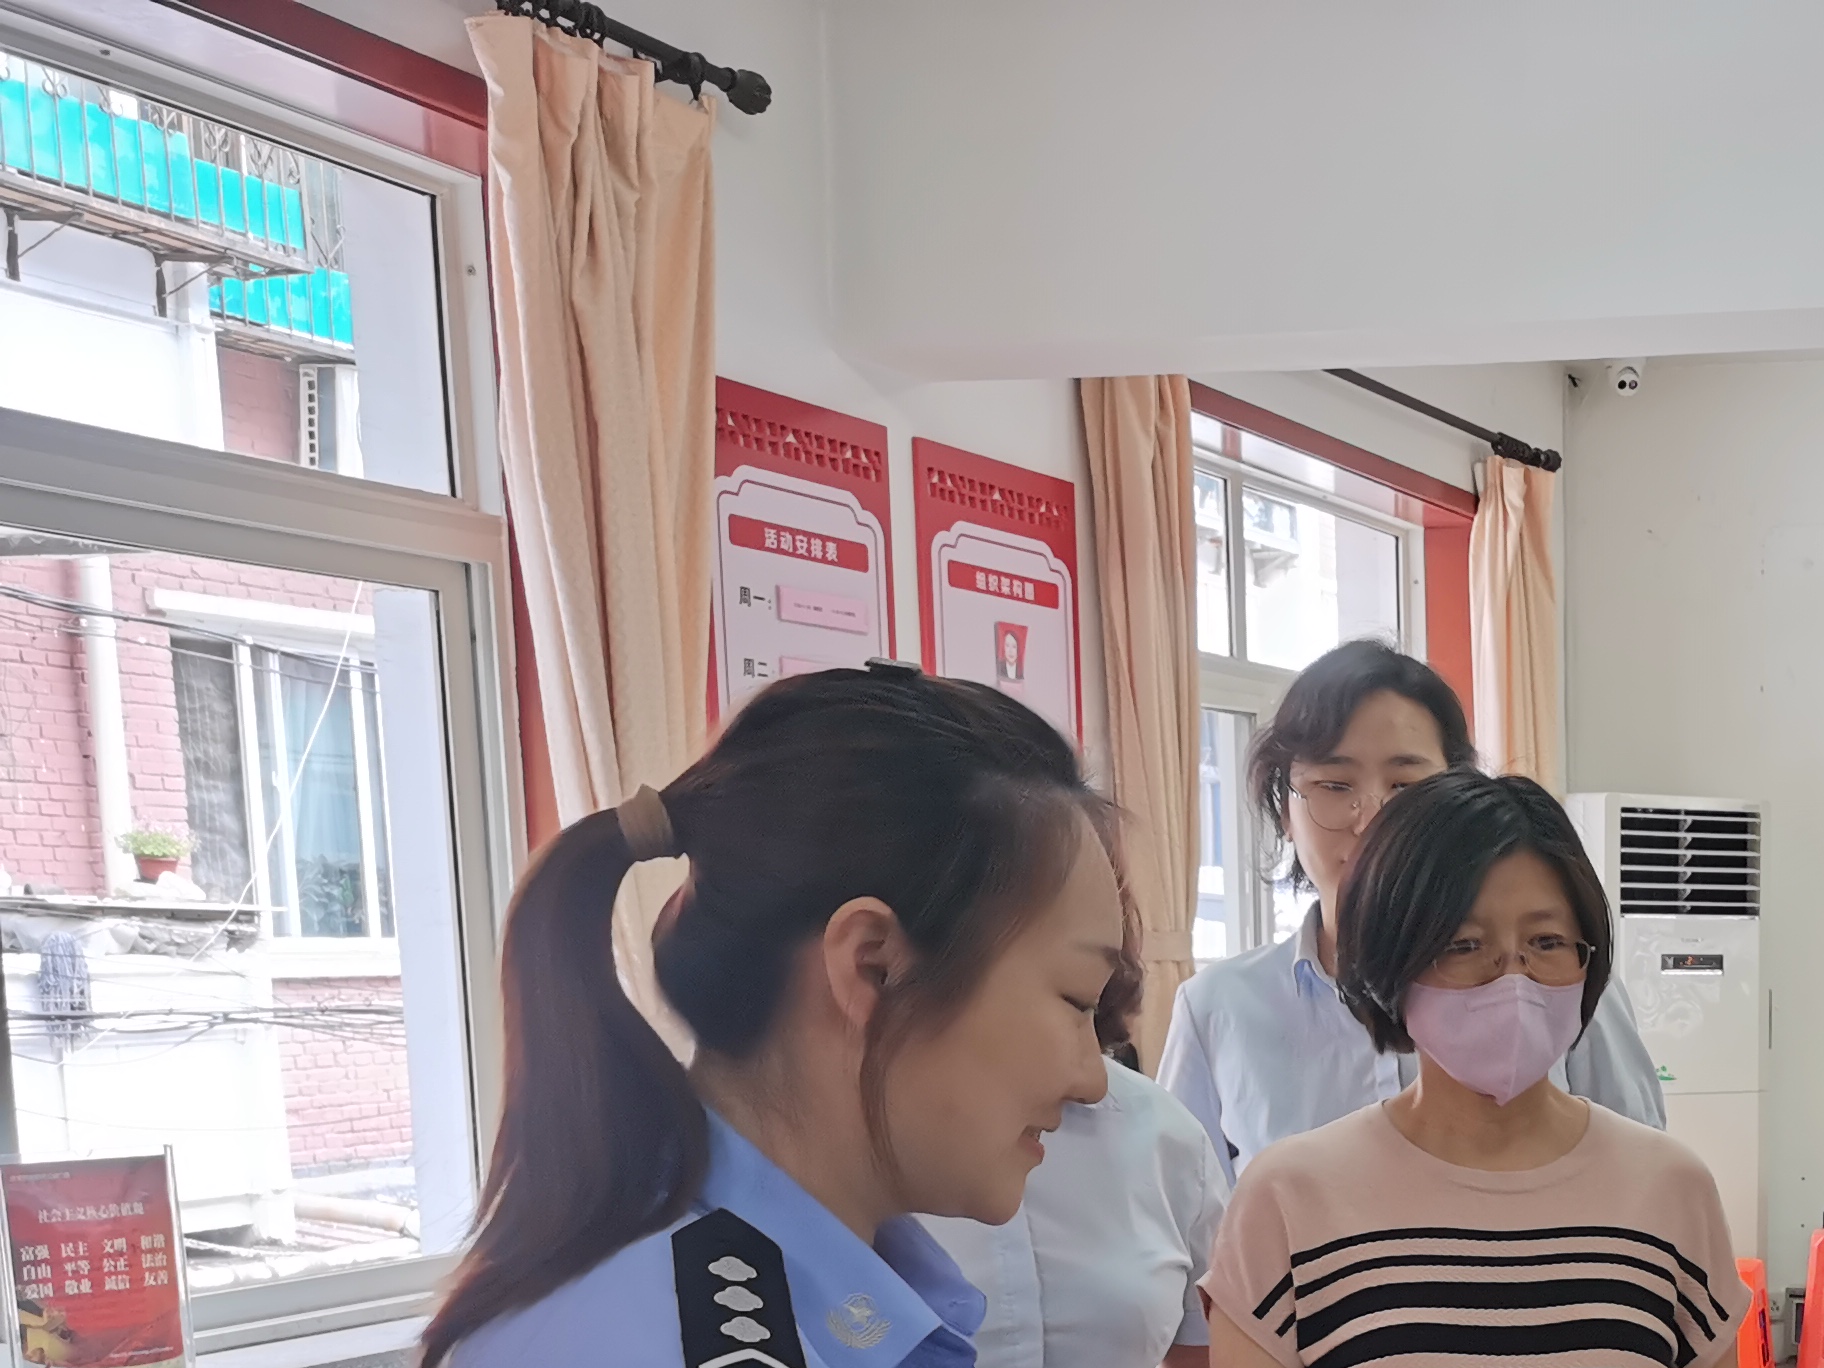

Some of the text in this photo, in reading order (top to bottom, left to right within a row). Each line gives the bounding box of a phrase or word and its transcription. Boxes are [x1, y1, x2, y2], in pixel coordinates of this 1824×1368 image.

[764, 528, 839, 562] 活动安排表
[38, 1202, 144, 1223] 社会主义核心价值观
[20, 1234, 165, 1261] 富强 民主 文明 和谐
[23, 1252, 167, 1281] 自由 平等 公正 法治
[25, 1270, 168, 1299] 爱国 敬业 诚信 友善
